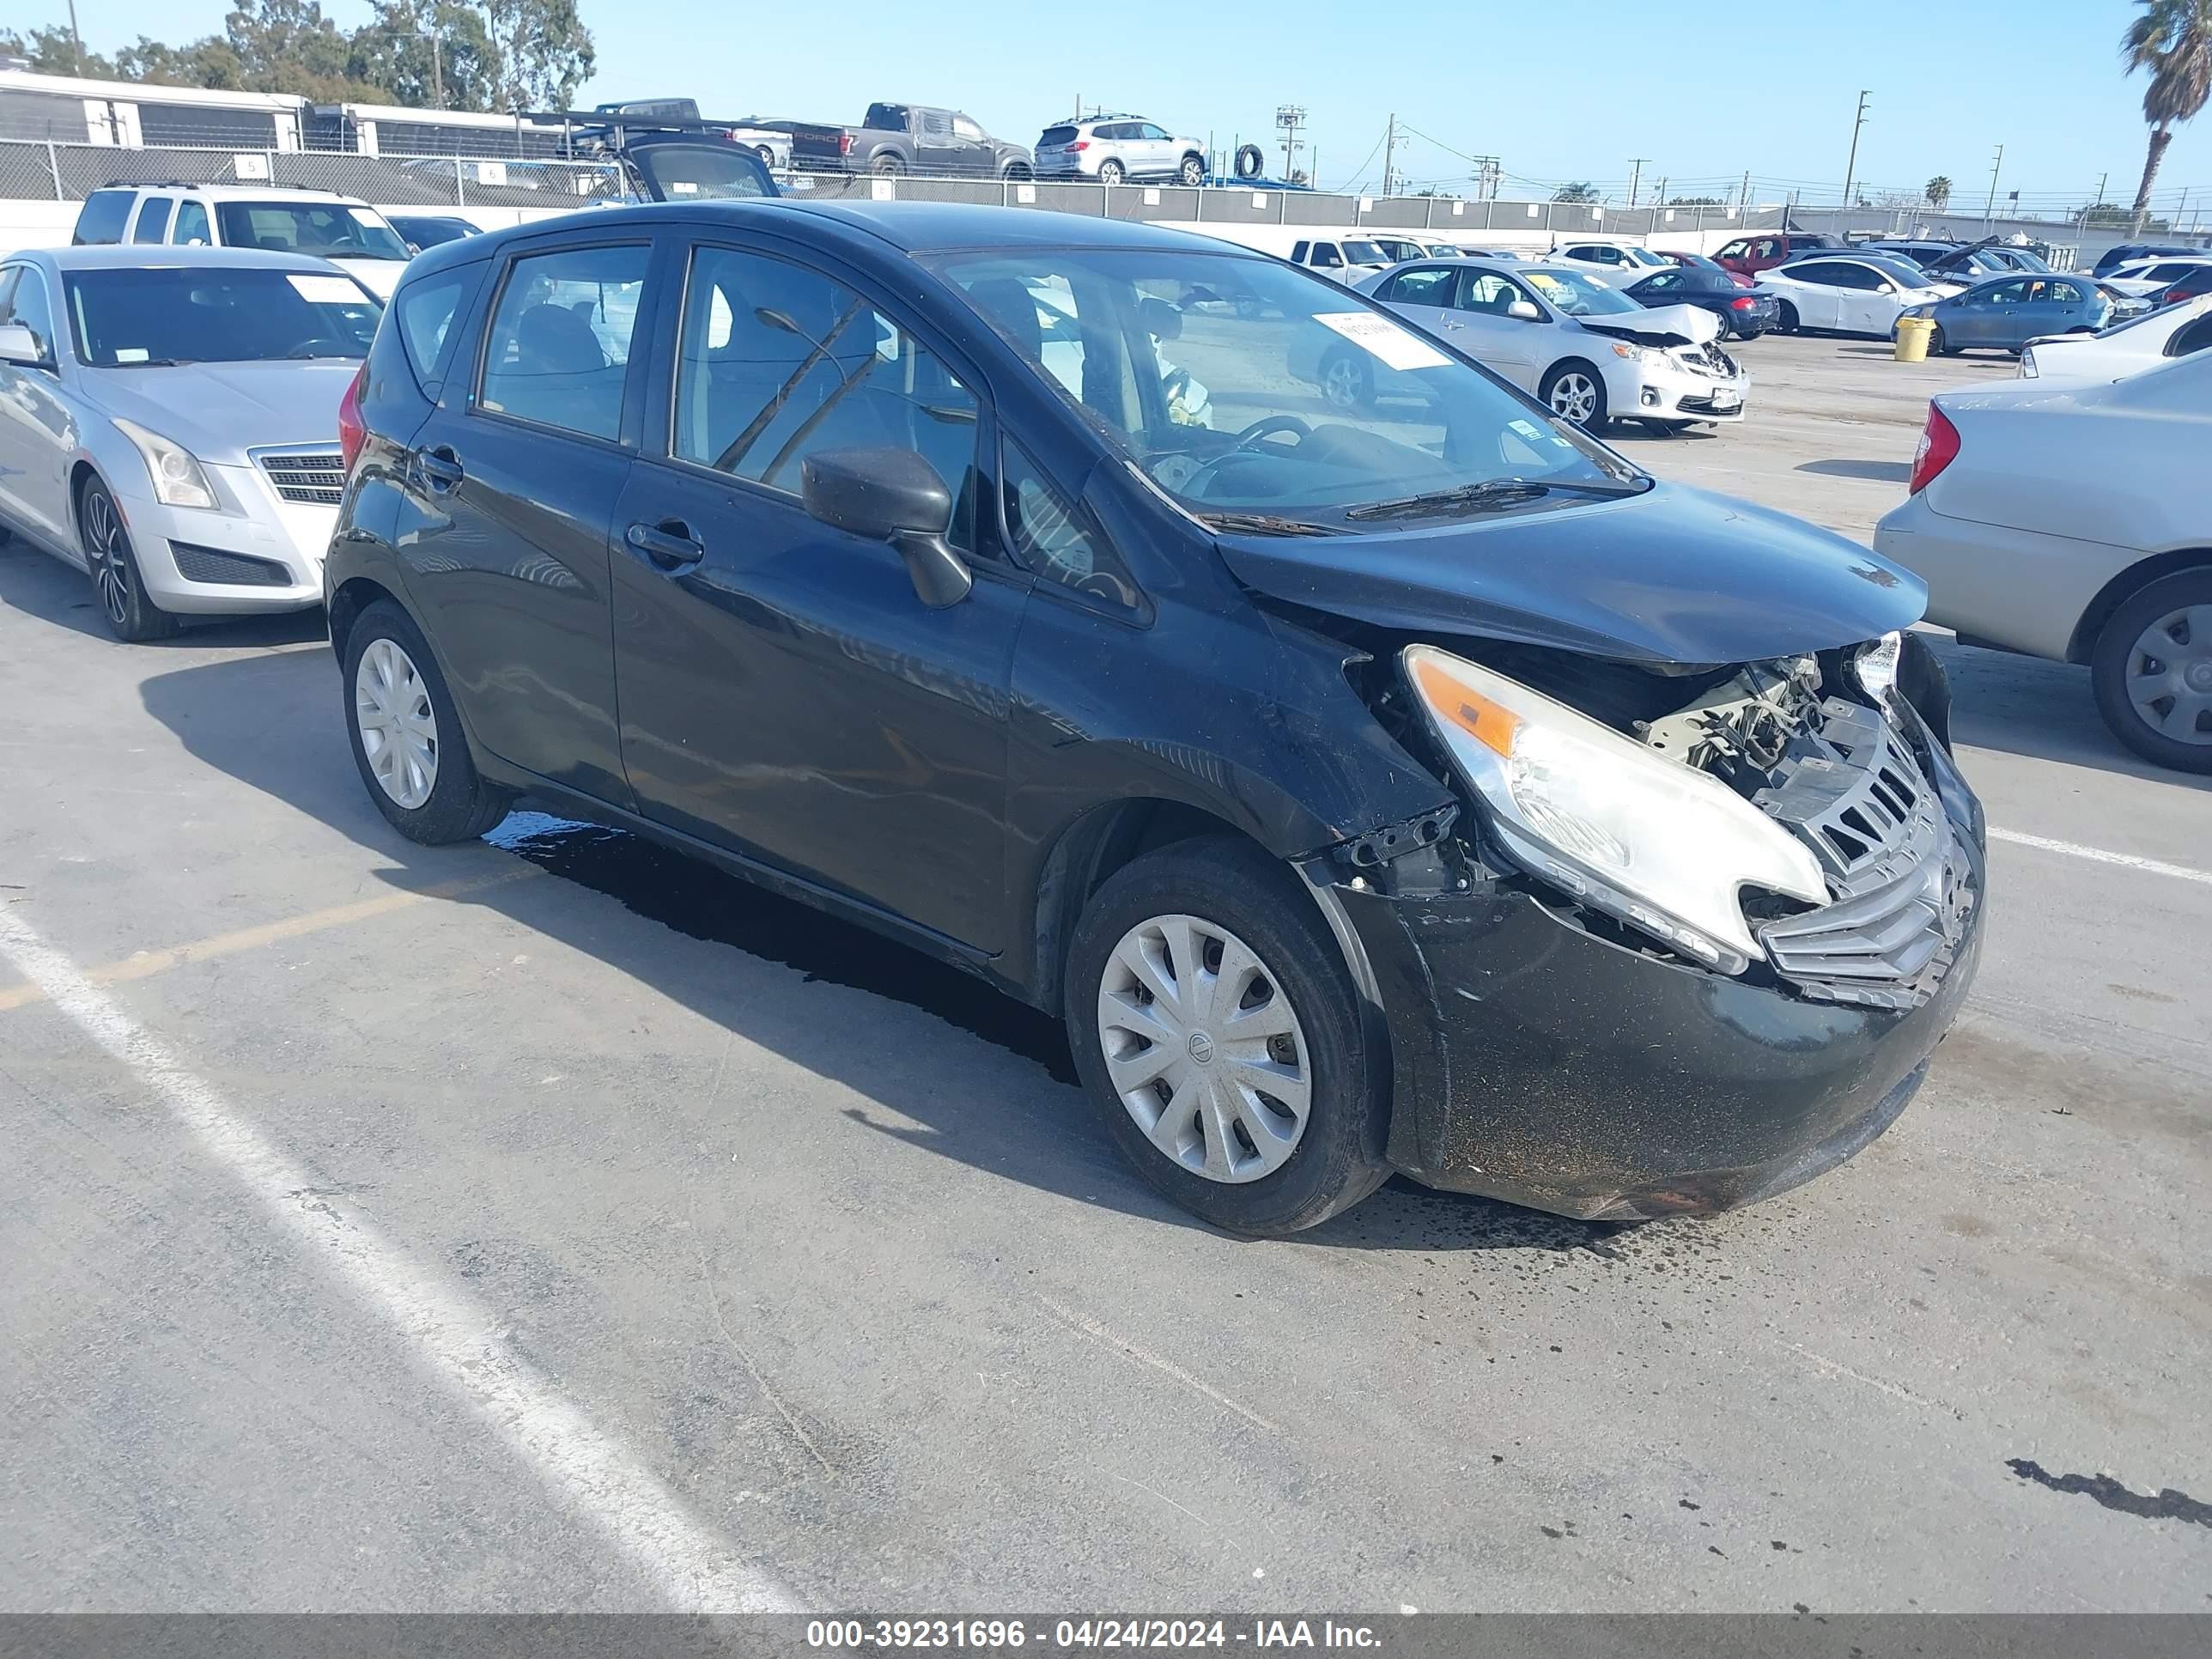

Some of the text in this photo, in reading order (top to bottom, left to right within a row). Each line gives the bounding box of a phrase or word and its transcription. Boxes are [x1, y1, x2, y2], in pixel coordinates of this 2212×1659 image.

[794, 131, 839, 143] FORD
[248, 161, 256, 172] 5
[489, 168, 496, 179] 6
